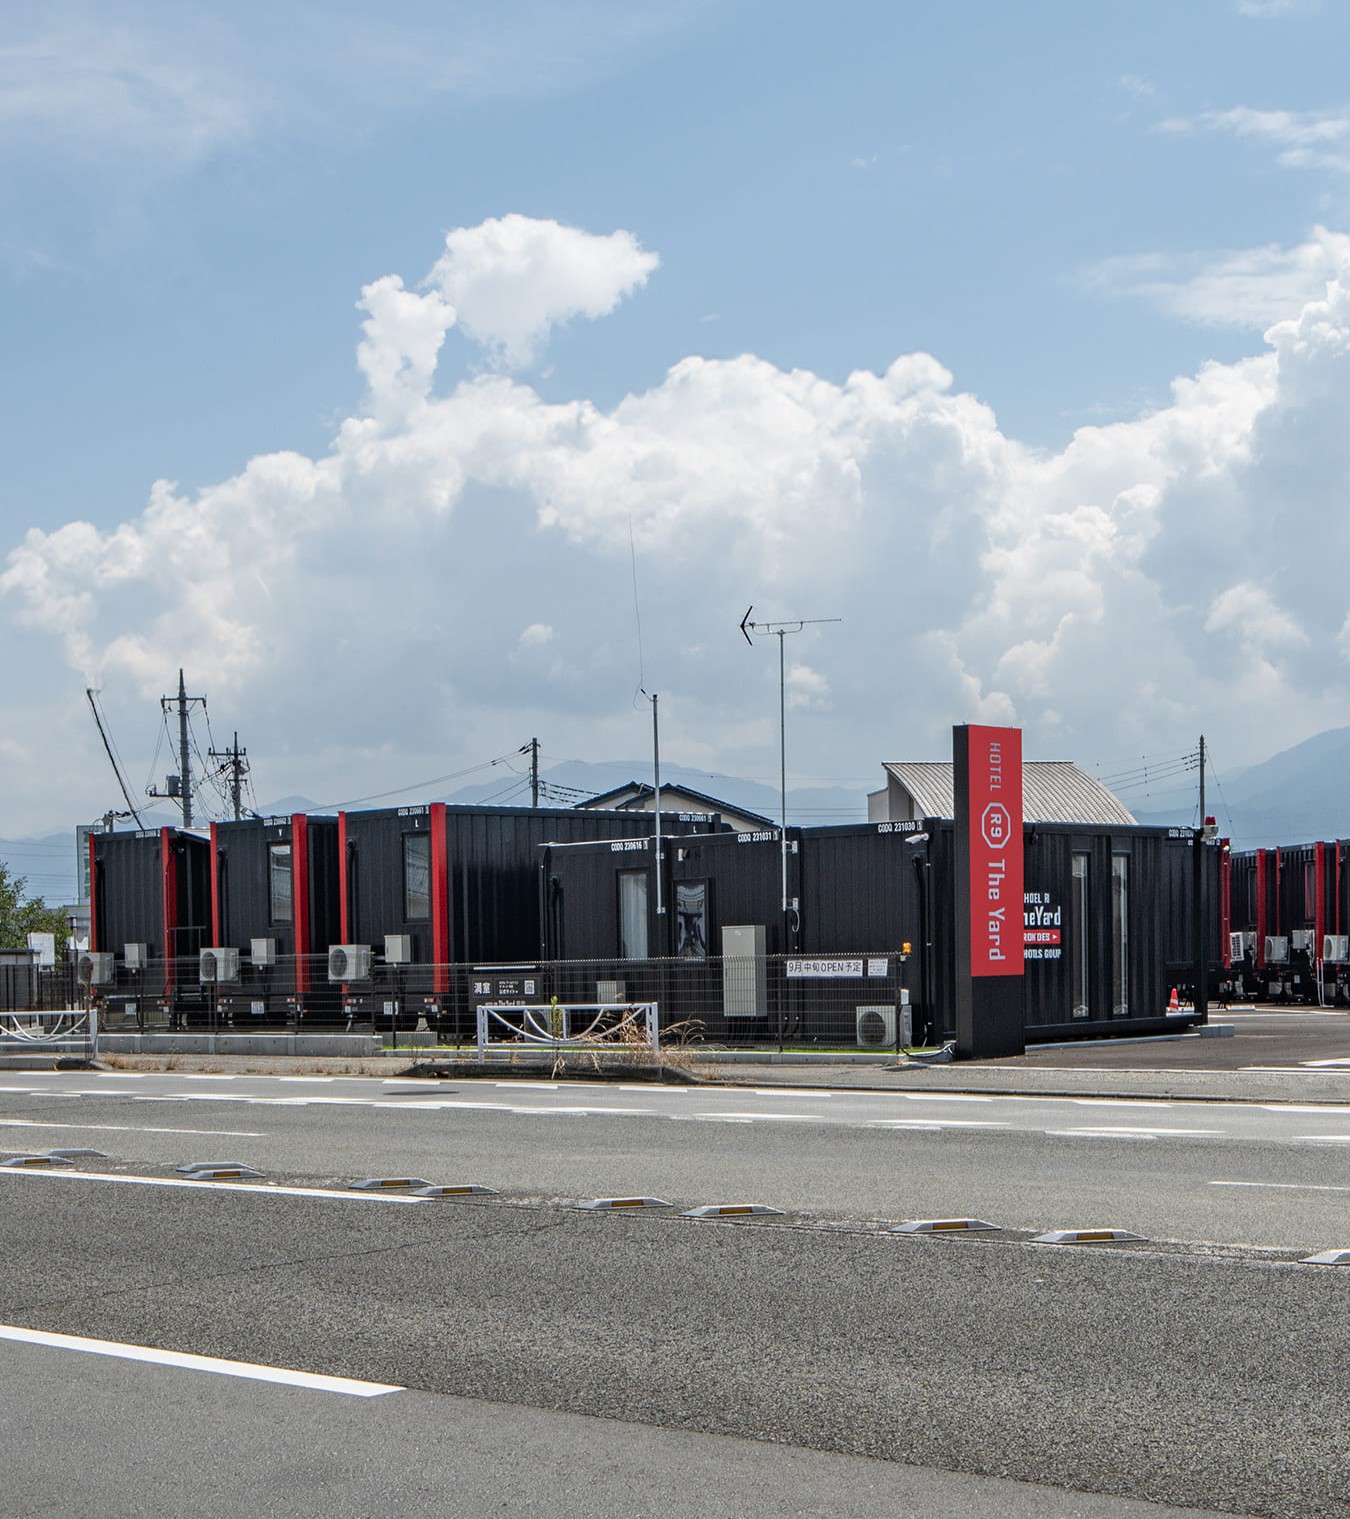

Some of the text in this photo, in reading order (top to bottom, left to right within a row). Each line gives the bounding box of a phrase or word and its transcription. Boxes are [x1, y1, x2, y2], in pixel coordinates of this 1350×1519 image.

[988, 742, 1006, 961] HOTEL R9 The Yard
[789, 961, 862, 973] 9月中旬OPEN予定
